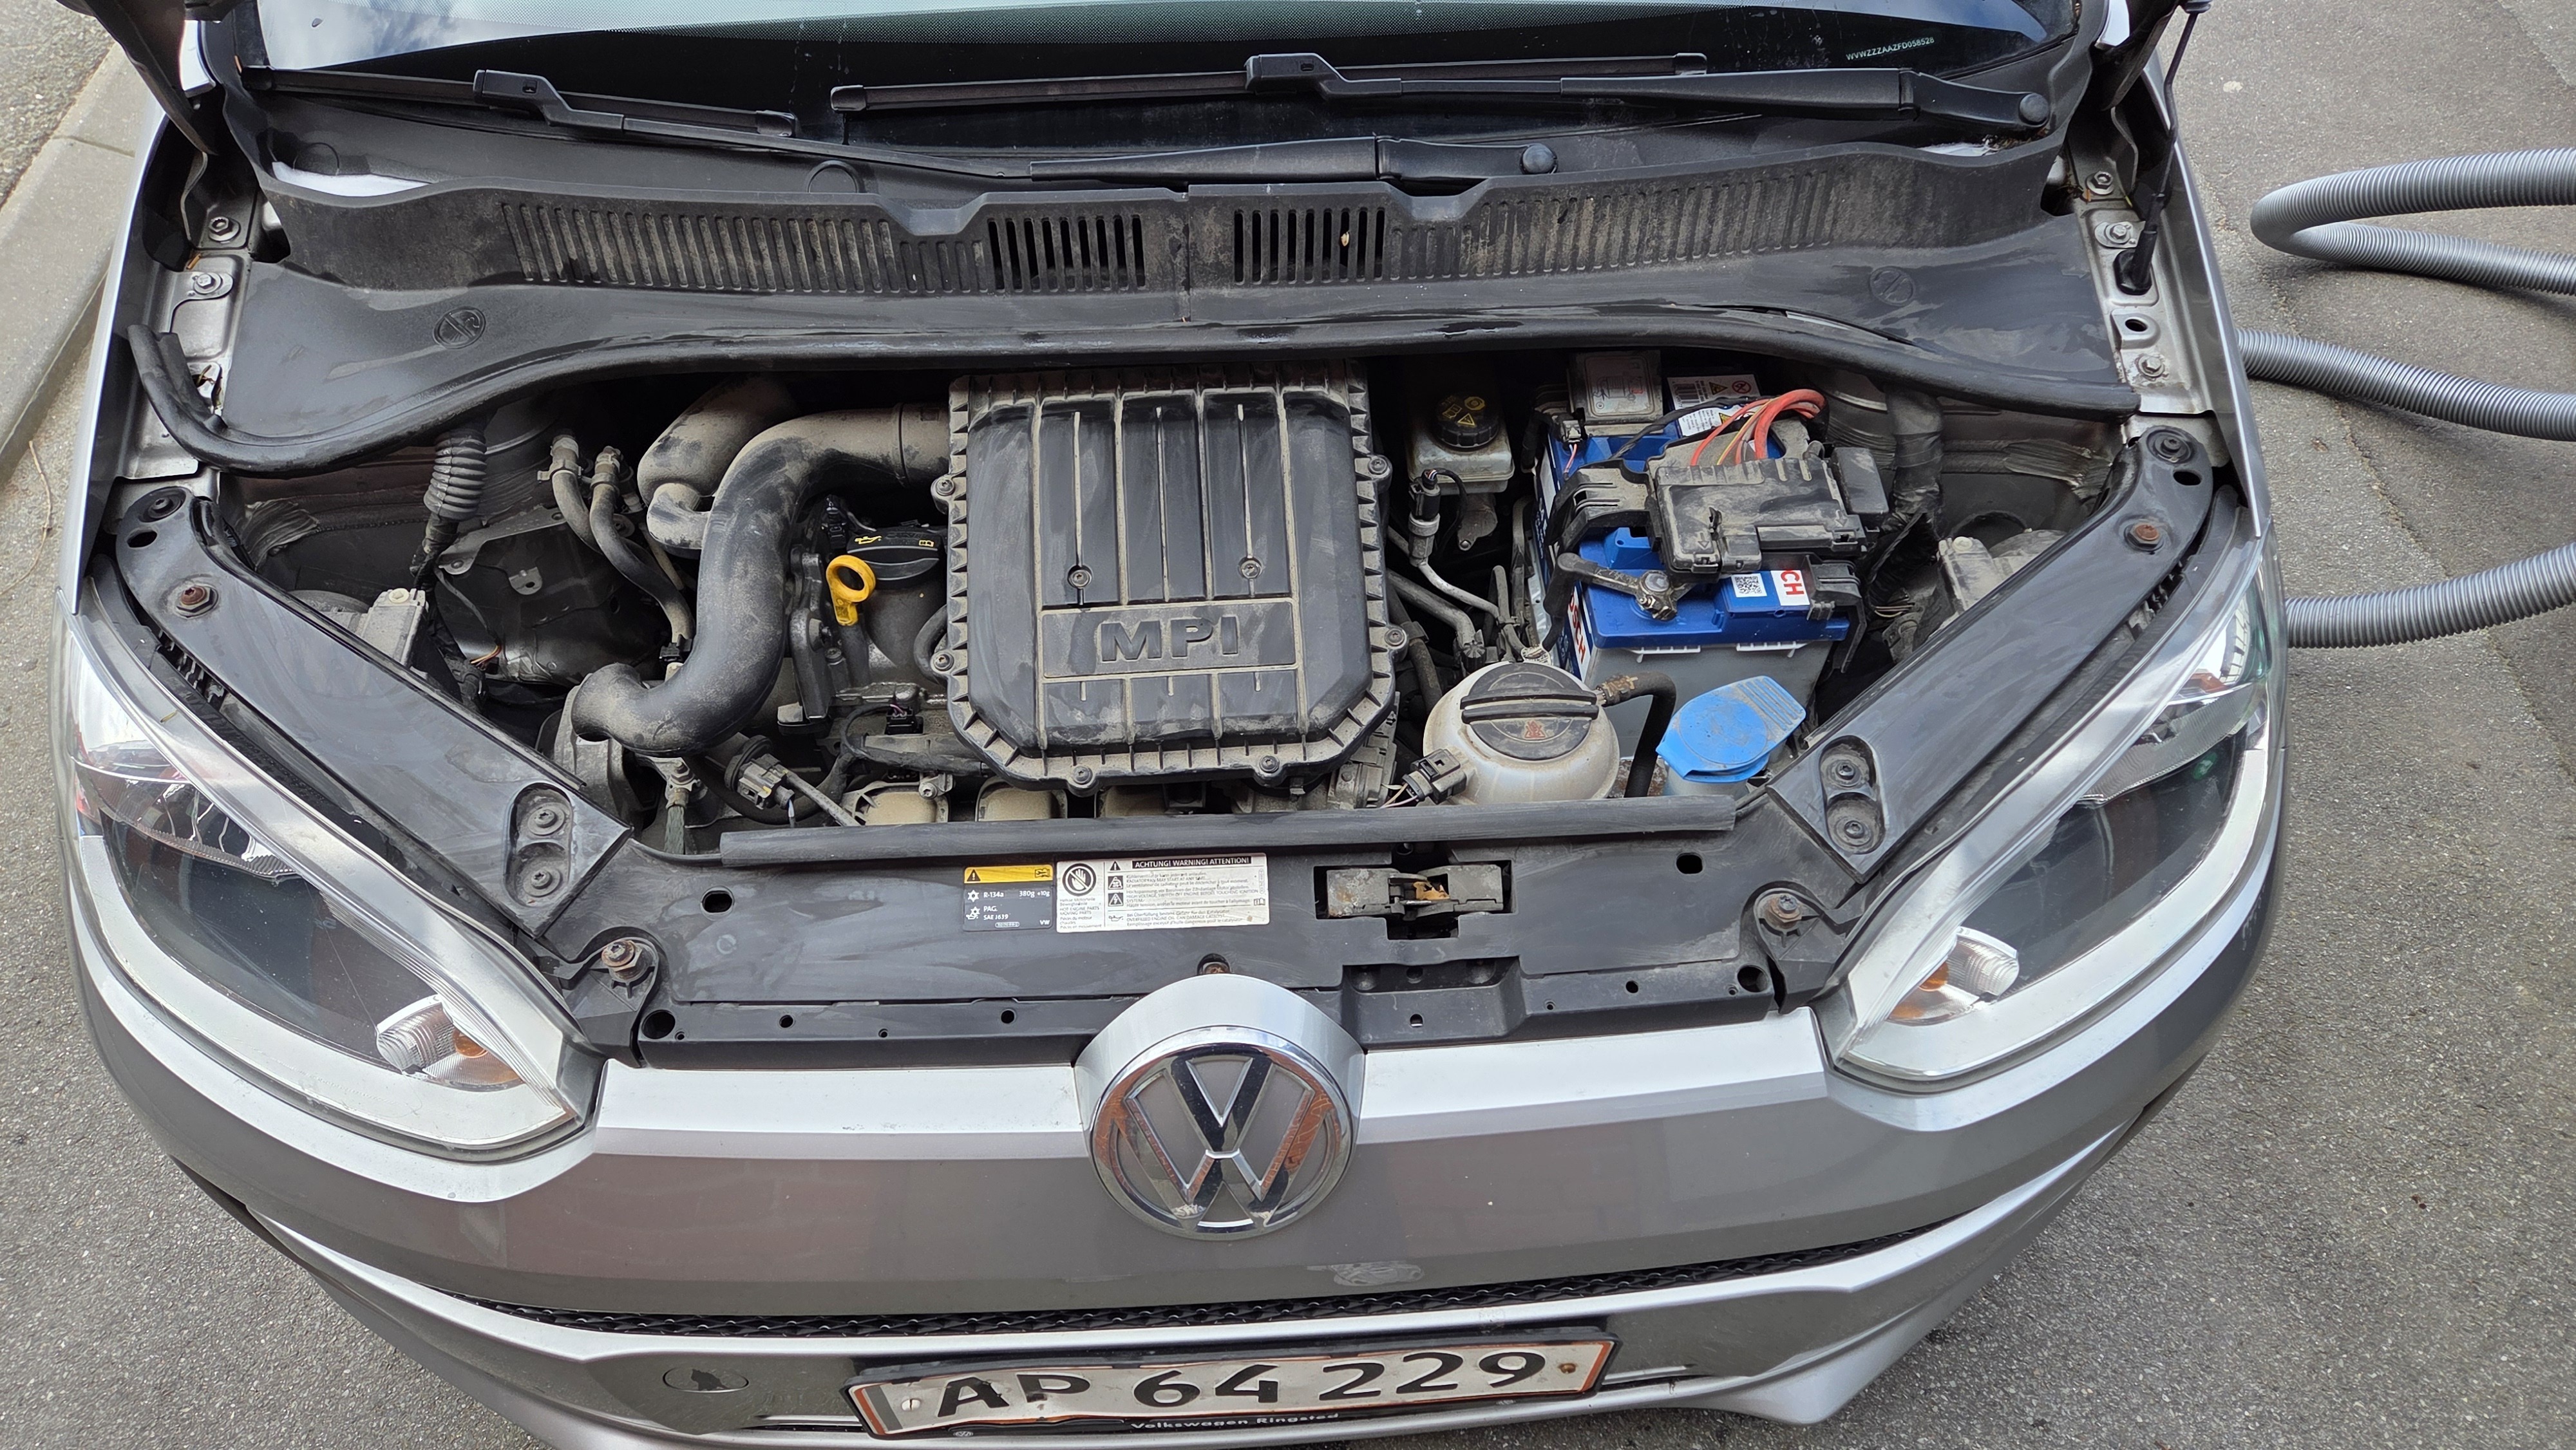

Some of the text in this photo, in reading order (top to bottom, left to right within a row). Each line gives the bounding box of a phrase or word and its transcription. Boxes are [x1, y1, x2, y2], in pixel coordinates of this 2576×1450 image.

[1846, 37, 1935, 61] WVWZZZAAZFD058528
[1781, 570, 1804, 595] CH
[1100, 616, 1239, 661] MPI
[1569, 594, 1586, 664] OSCH
[937, 1350, 1546, 1418] AP 64 229
[1130, 1413, 1340, 1429] Volkswagen Ringsted
